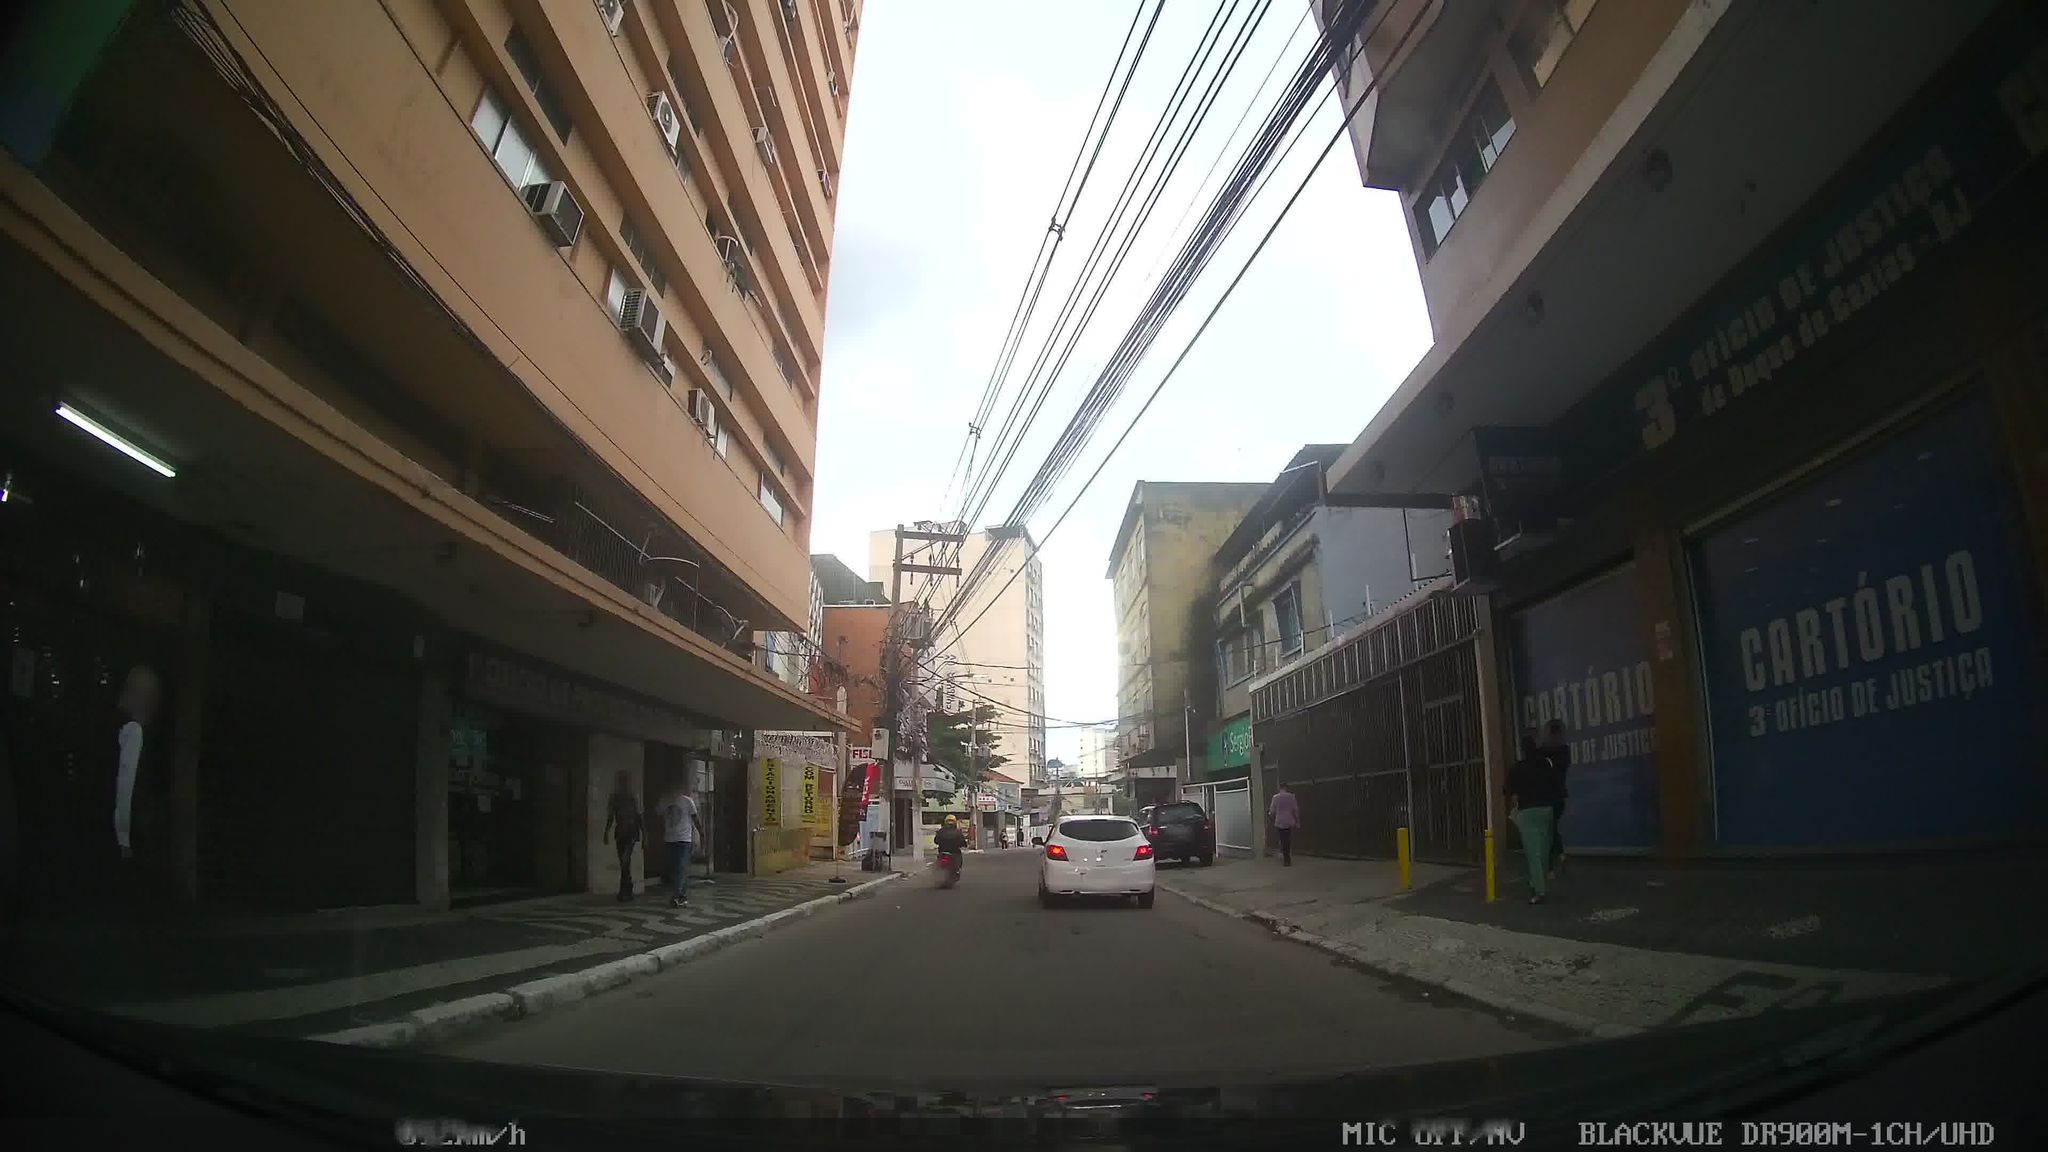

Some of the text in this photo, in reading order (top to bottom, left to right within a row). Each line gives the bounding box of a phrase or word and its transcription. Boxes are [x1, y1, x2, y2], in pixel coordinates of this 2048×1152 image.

[1798, 309, 1829, 348] de
[1740, 549, 1984, 692] CARTÓRIO
[1523, 660, 1656, 738] CARTÓRIO
[1775, 686, 1846, 733] OFÍCIO
[1850, 677, 1880, 718] DE
[1887, 646, 1993, 710] JUSTIÇA
[1582, 739, 1596, 764] DE
